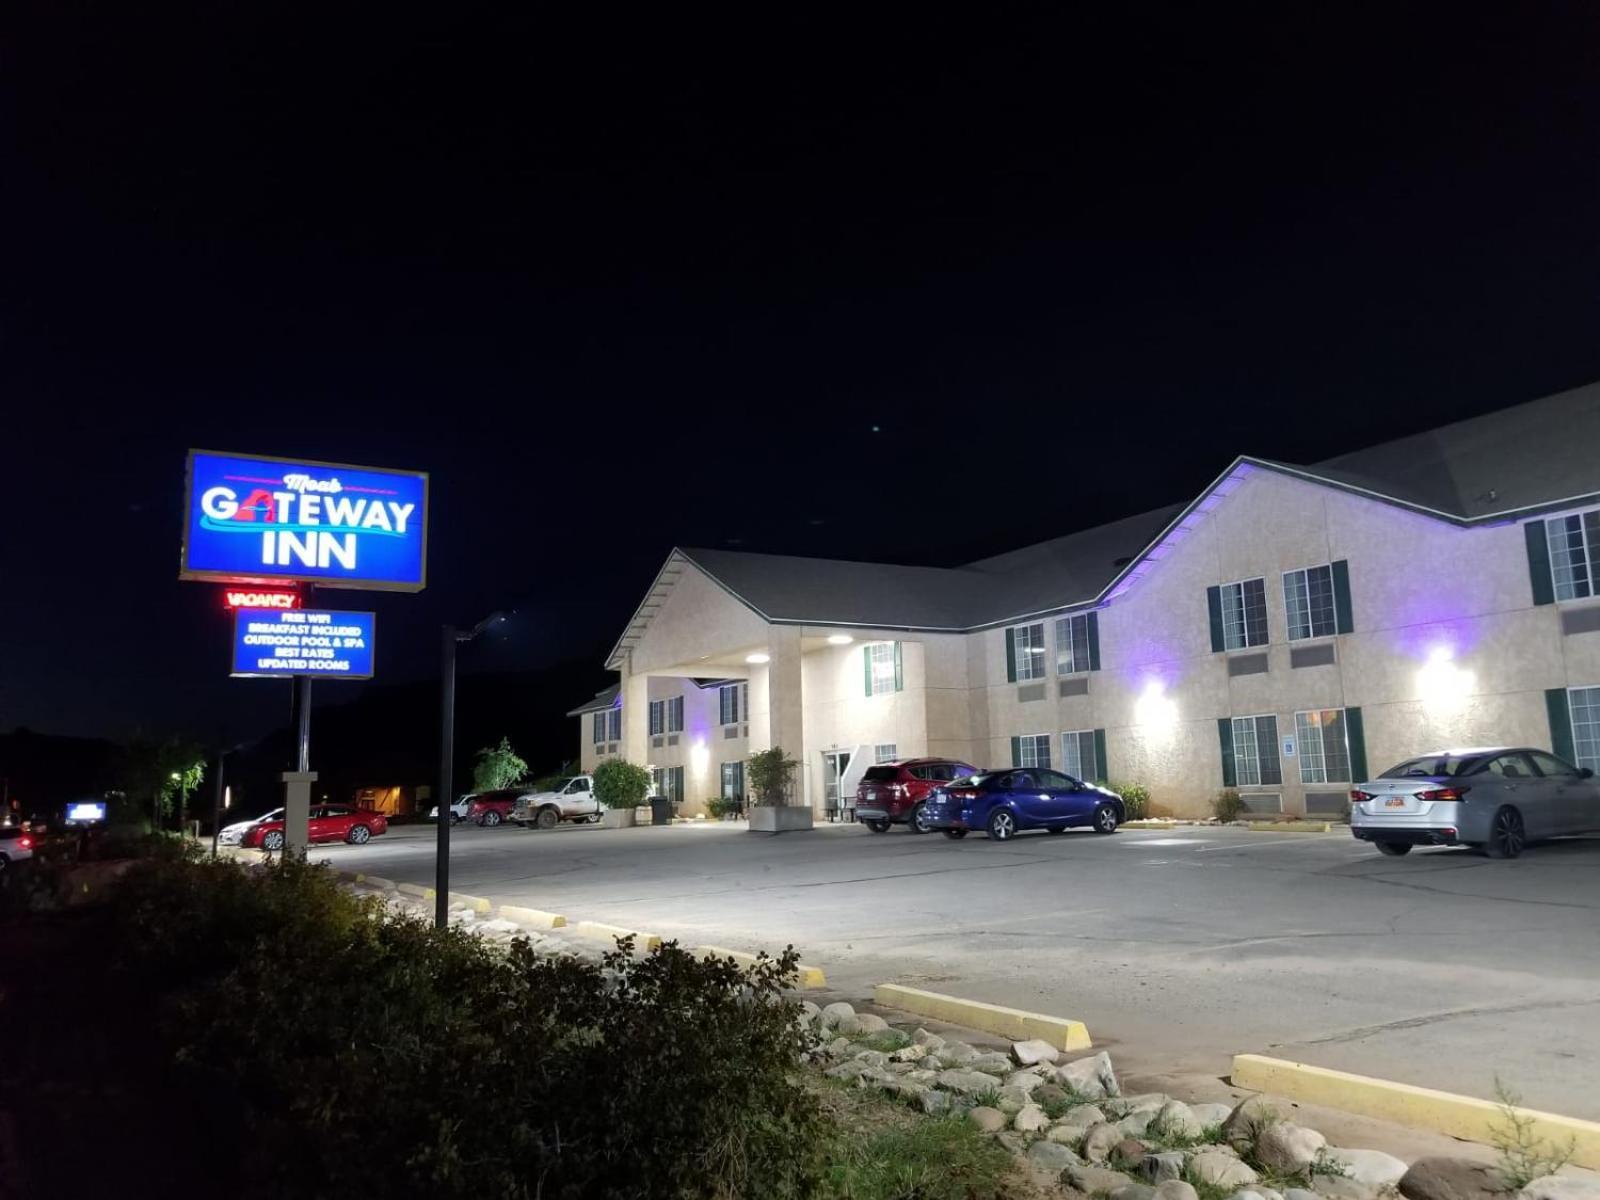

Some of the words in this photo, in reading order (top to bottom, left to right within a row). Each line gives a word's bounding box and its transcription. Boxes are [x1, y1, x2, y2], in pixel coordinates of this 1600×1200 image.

[201, 486, 415, 533] GATEWAY
[262, 531, 357, 569] INN
[227, 592, 296, 608] VACANCY
[281, 613, 306, 623] FREE
[248, 623, 311, 634] BREAKFAST
[311, 625, 362, 636] INCLUDED
[243, 634, 299, 646] OUTDOOR
[301, 636, 331, 647] POOL
[333, 637, 342, 647] &
[343, 638, 365, 648] SPA
[275, 647, 300, 658] BEST
[301, 648, 335, 659] RATES
[257, 658, 307, 670] UPDATED
[308, 660, 350, 671] ROOMS
